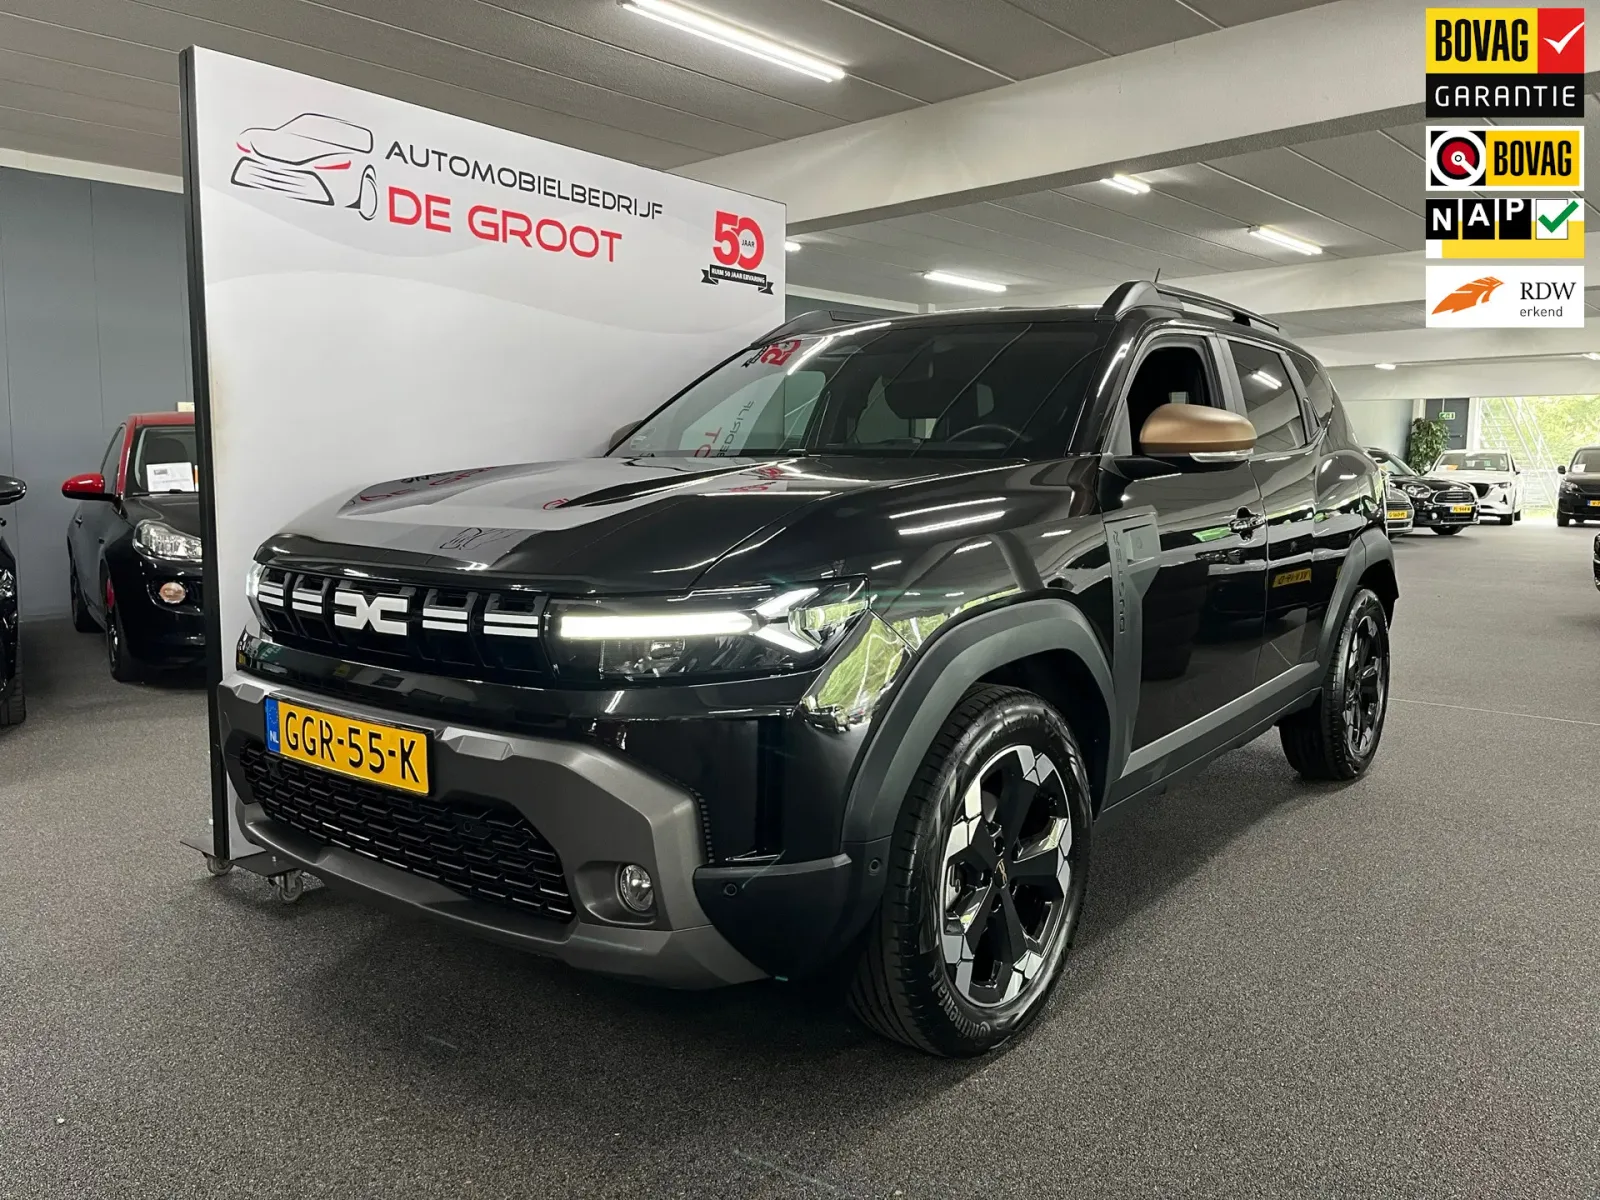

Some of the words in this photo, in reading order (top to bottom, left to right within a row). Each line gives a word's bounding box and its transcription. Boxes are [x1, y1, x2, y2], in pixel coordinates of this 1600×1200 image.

[385, 141, 663, 220] AUTOMOBIELBEDRIJF
[388, 186, 451, 233] DE
[468, 205, 622, 262] GROOT
[713, 210, 764, 270] 50
[741, 239, 755, 248] JAAR
[711, 267, 724, 276] RUIM
[724, 269, 731, 277] 50
[731, 271, 742, 279] JAAR
[742, 273, 765, 284] ERVARING
[269, 731, 280, 744] NL
[285, 711, 420, 783] GGR-55-K
